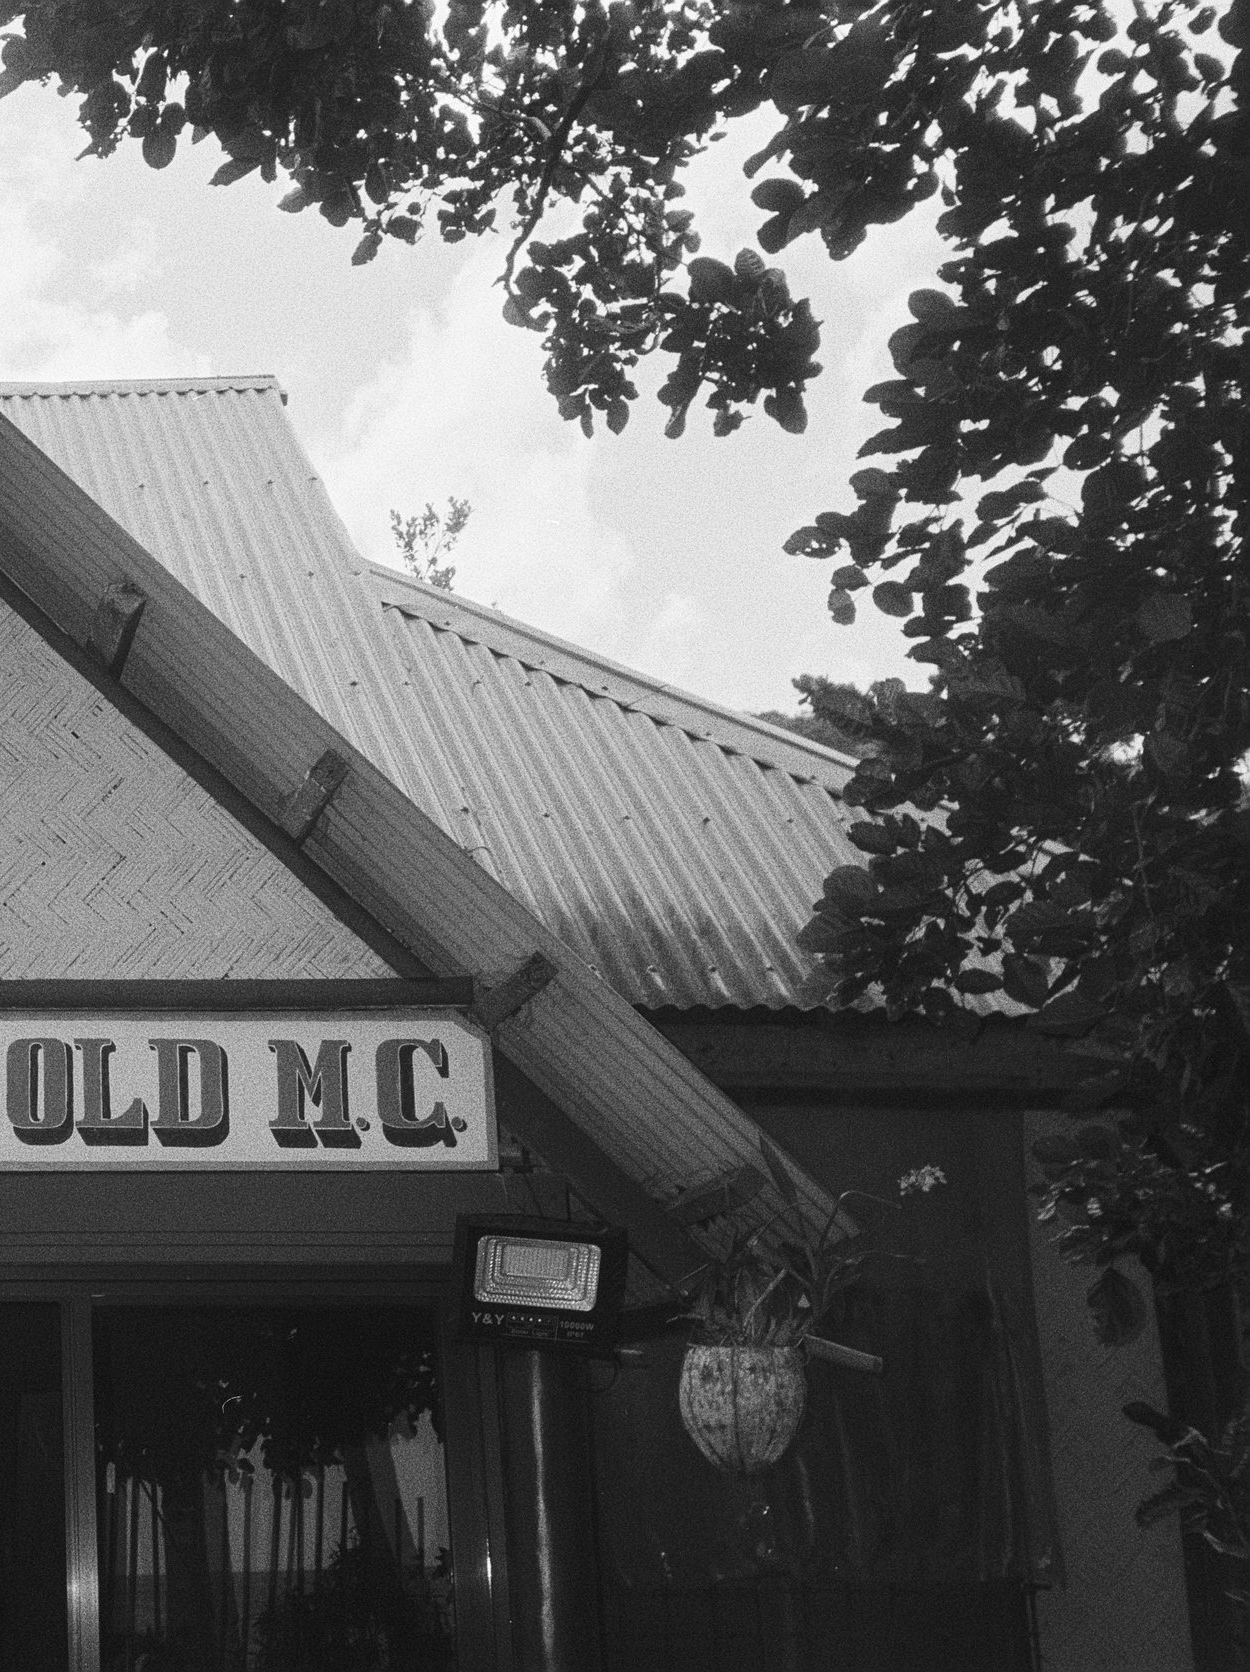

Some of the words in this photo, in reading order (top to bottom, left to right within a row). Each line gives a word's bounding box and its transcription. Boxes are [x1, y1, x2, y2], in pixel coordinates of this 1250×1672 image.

[6, 1037, 230, 1148] OLD
[268, 1038, 467, 1149] M.C.
[472, 1312, 504, 1325] Y&Y
